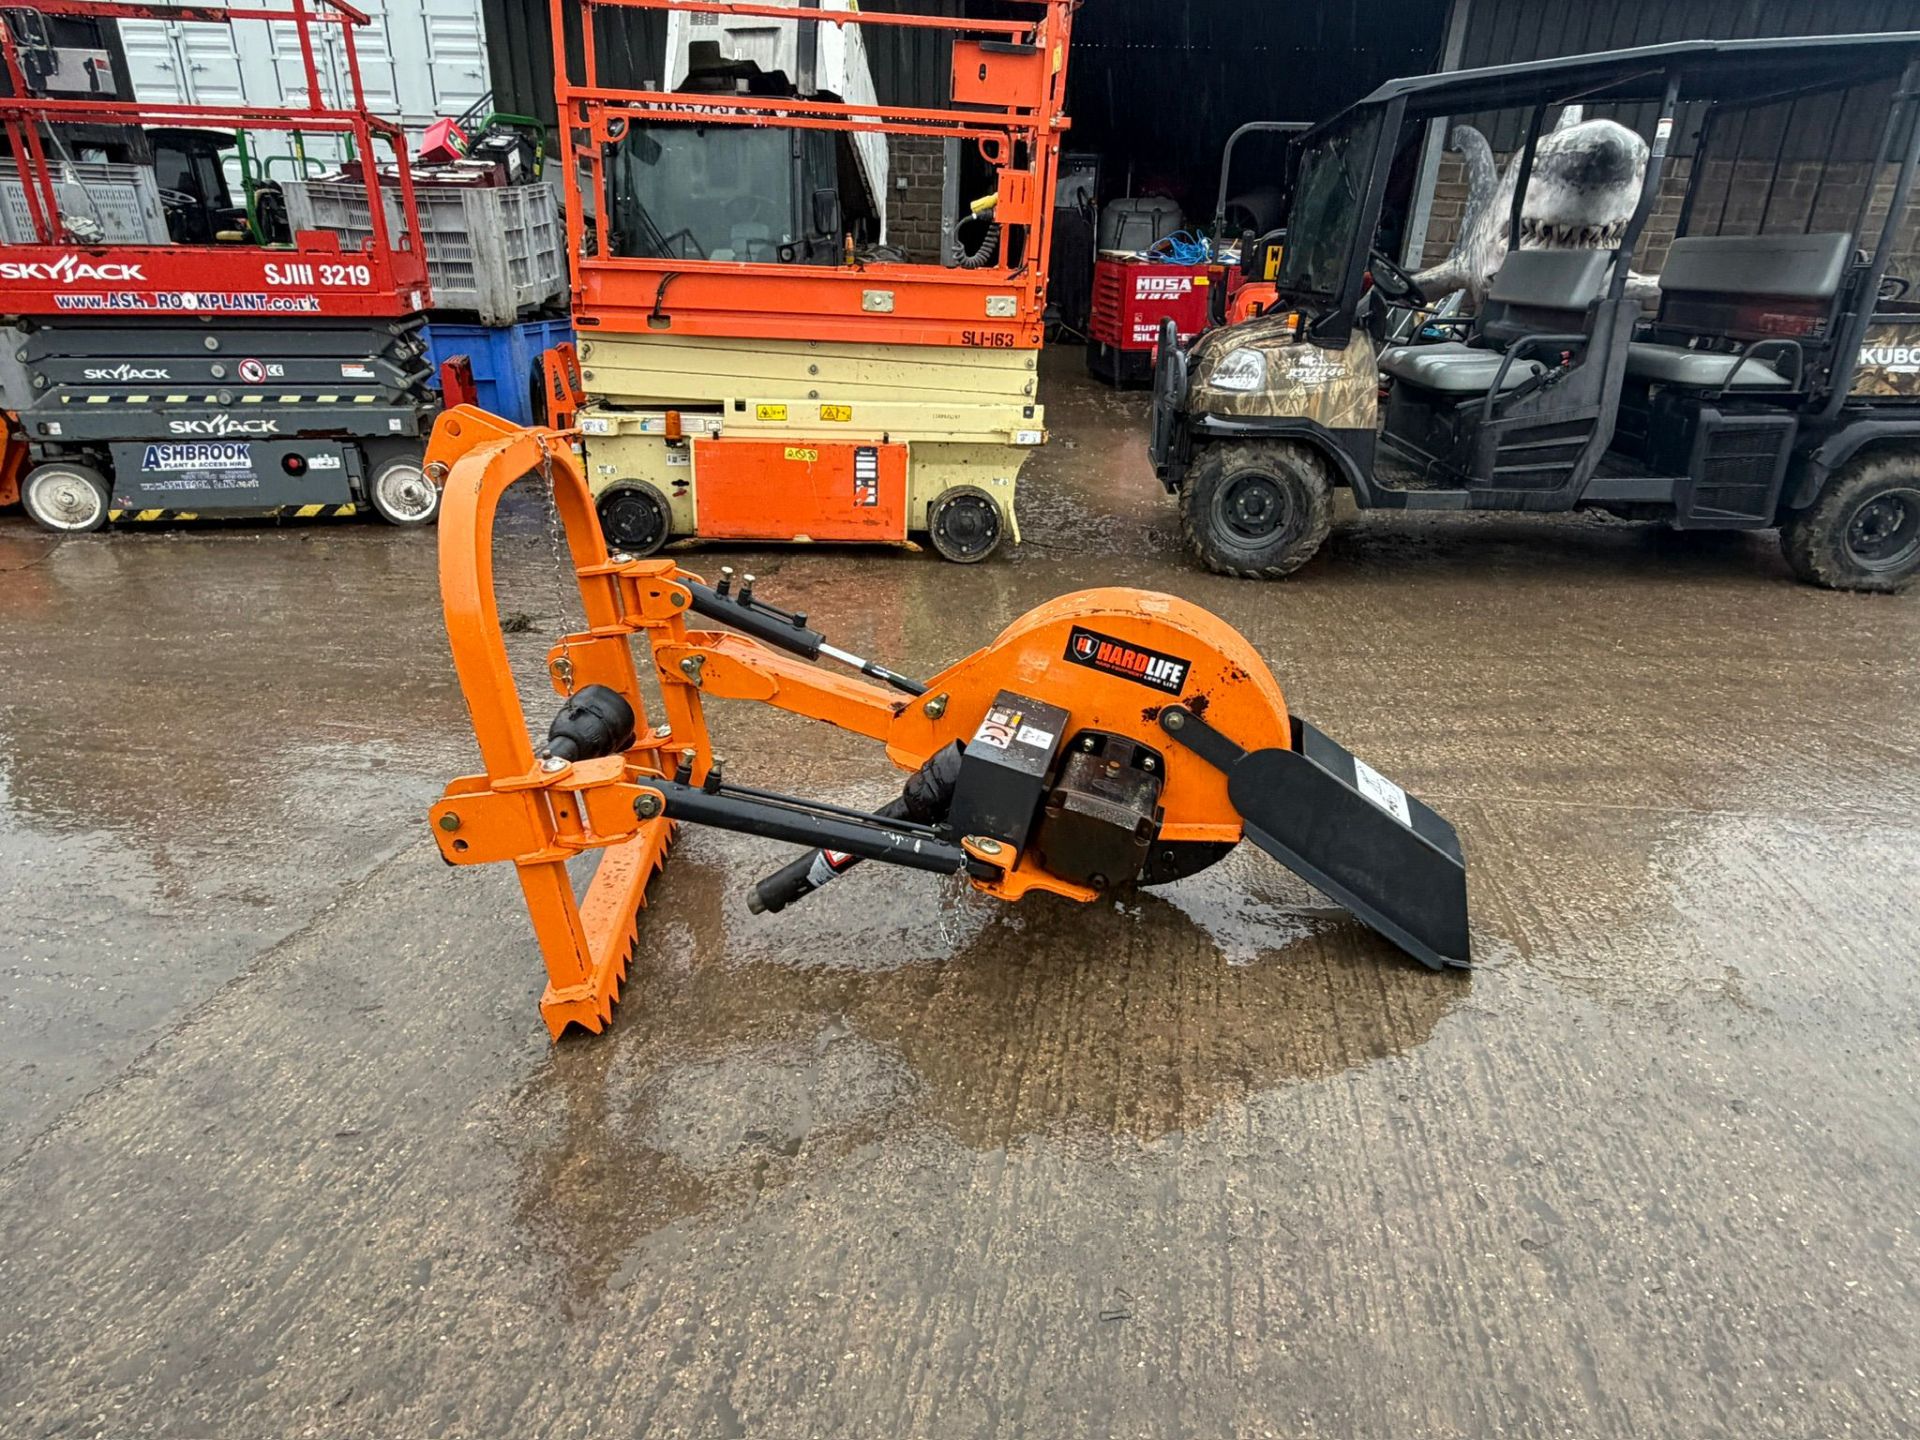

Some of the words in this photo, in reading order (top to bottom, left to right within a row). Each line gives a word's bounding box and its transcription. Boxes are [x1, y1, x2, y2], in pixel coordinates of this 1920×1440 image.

[0, 253, 147, 283] SKYJACK
[319, 264, 371, 286] 3219
[1136, 278, 1192, 290] MOSA
[83, 364, 171, 381] SKYJACK
[169, 413, 280, 436] SKYJACK
[143, 444, 250, 468] ASHBROOK
[1097, 641, 1184, 684] HARDLIFE
